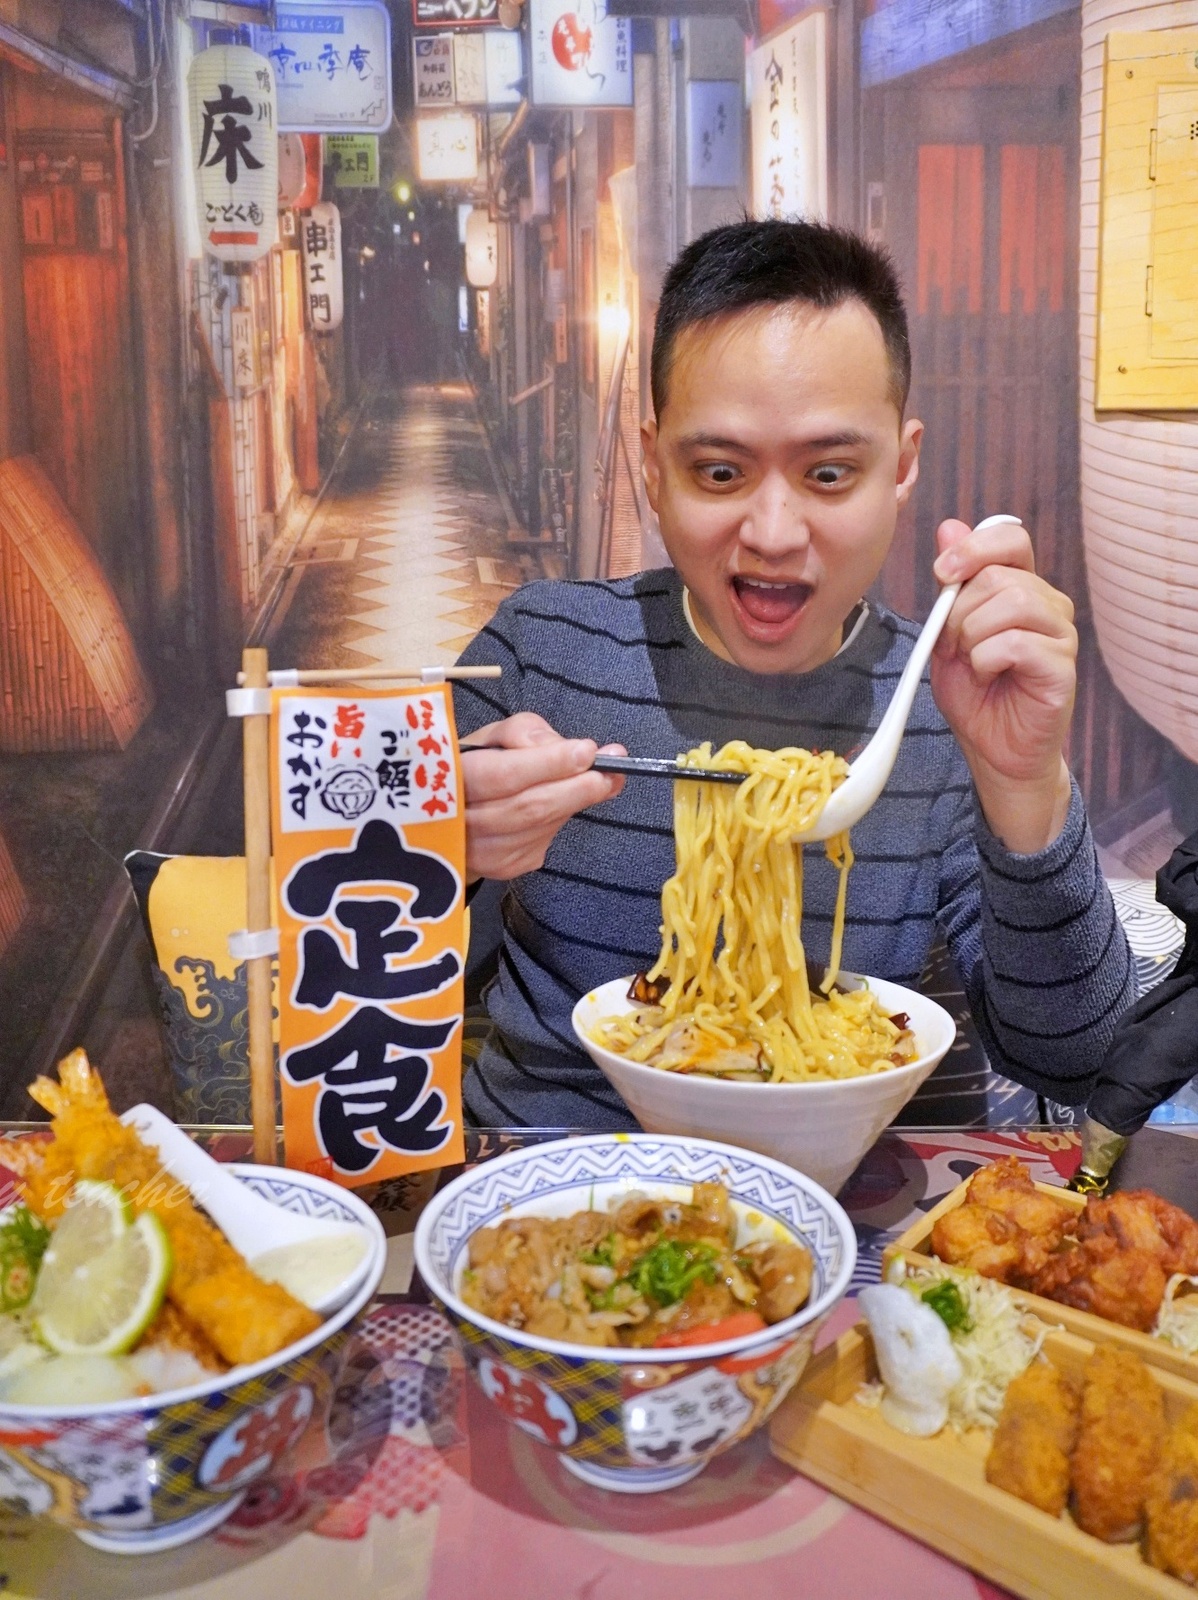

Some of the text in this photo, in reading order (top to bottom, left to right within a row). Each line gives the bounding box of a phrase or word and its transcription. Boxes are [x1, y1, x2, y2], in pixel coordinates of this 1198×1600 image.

[198, 83, 266, 185] 床
[286, 710, 327, 821] おかず
[329, 703, 366, 759] 旨い
[375, 729, 413, 810] ご飯に
[405, 699, 456, 818] ほかほか
[284, 816, 461, 1173] 定食
